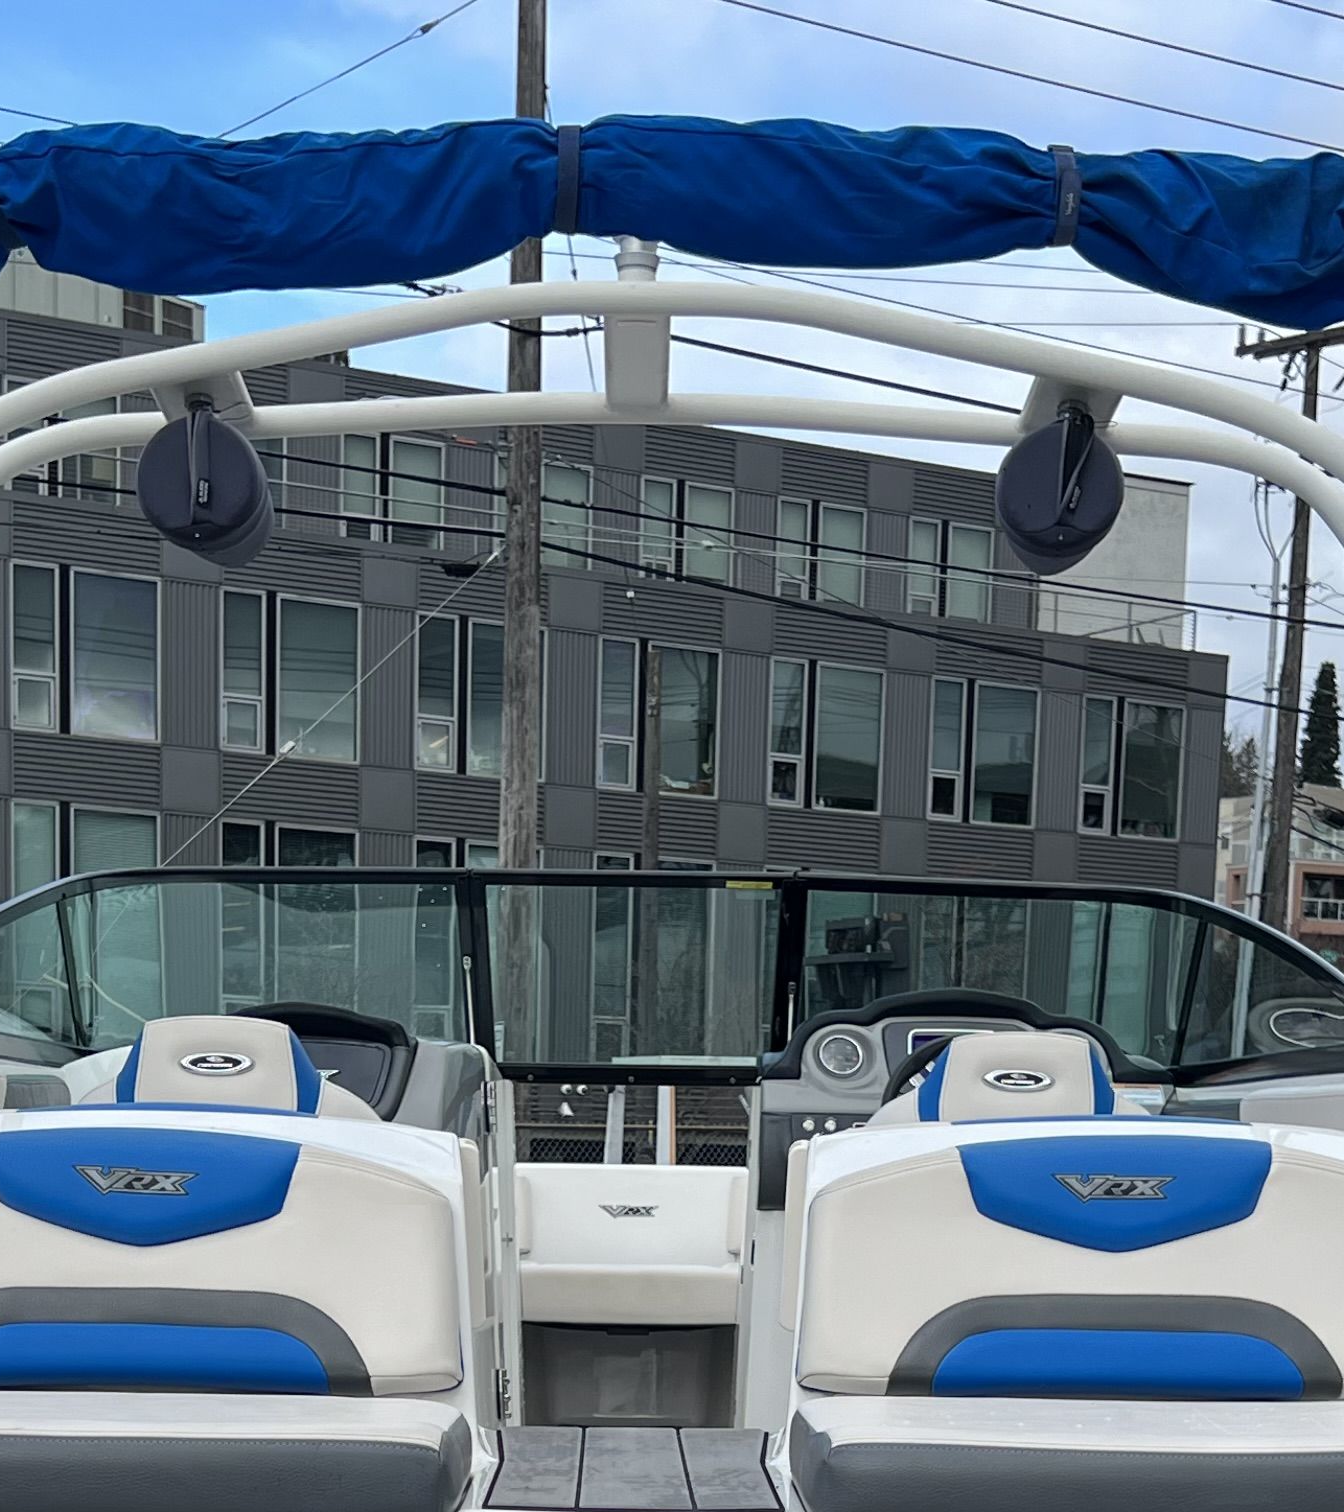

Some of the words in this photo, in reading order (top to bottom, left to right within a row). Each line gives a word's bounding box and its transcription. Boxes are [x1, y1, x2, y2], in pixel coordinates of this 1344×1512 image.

[73, 1164, 199, 1196] VRX
[1051, 1172, 1177, 1203] VRX
[598, 1204, 659, 1219] VRX
